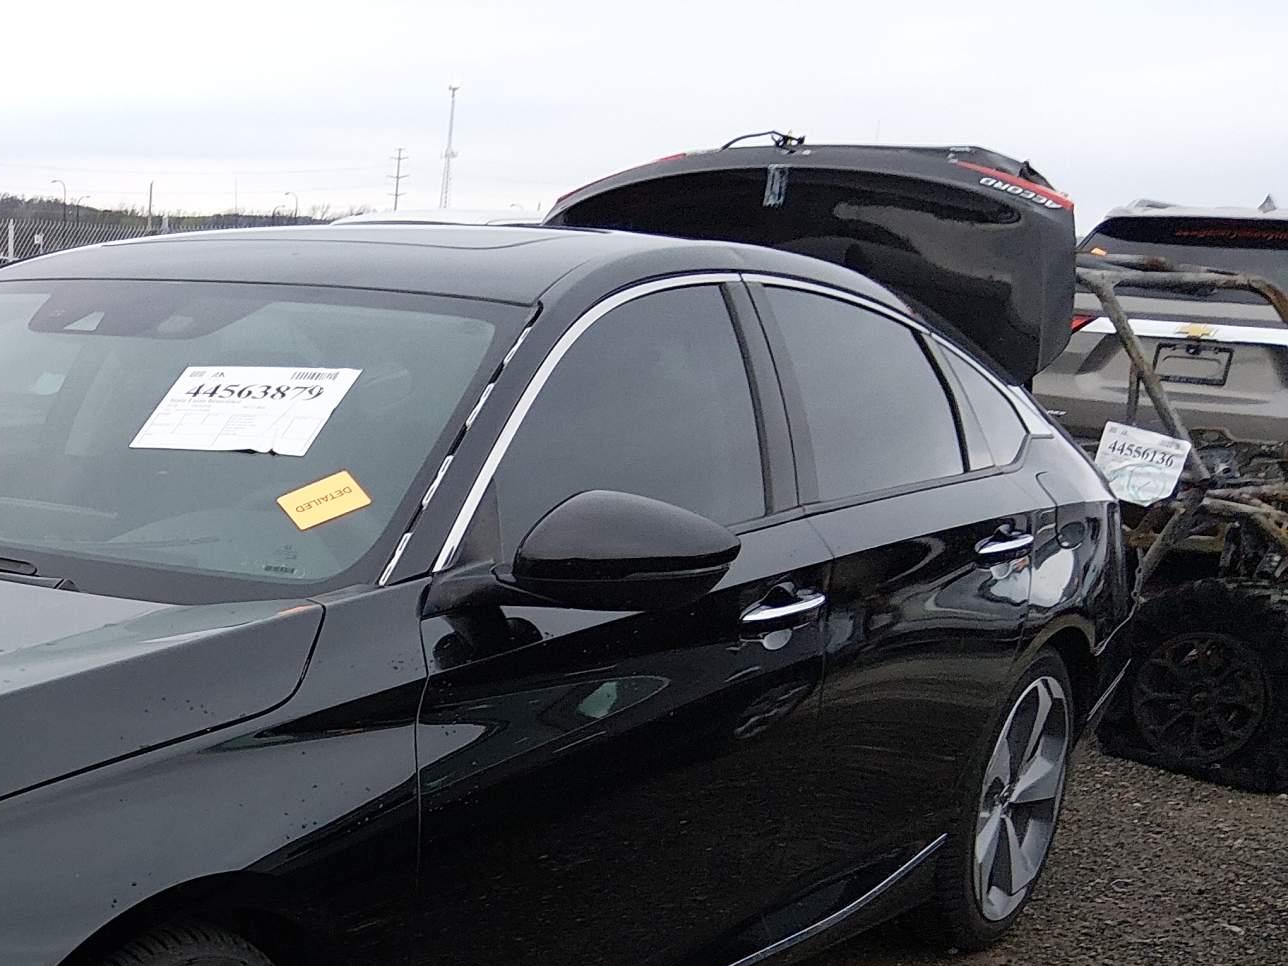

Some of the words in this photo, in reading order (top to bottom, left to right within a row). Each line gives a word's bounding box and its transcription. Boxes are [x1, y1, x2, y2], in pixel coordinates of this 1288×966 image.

[979, 177, 1063, 209] ACCORD
[185, 383, 325, 401] 44563879
[1108, 439, 1176, 468] 44556136
[295, 485, 353, 514] DETAILED
